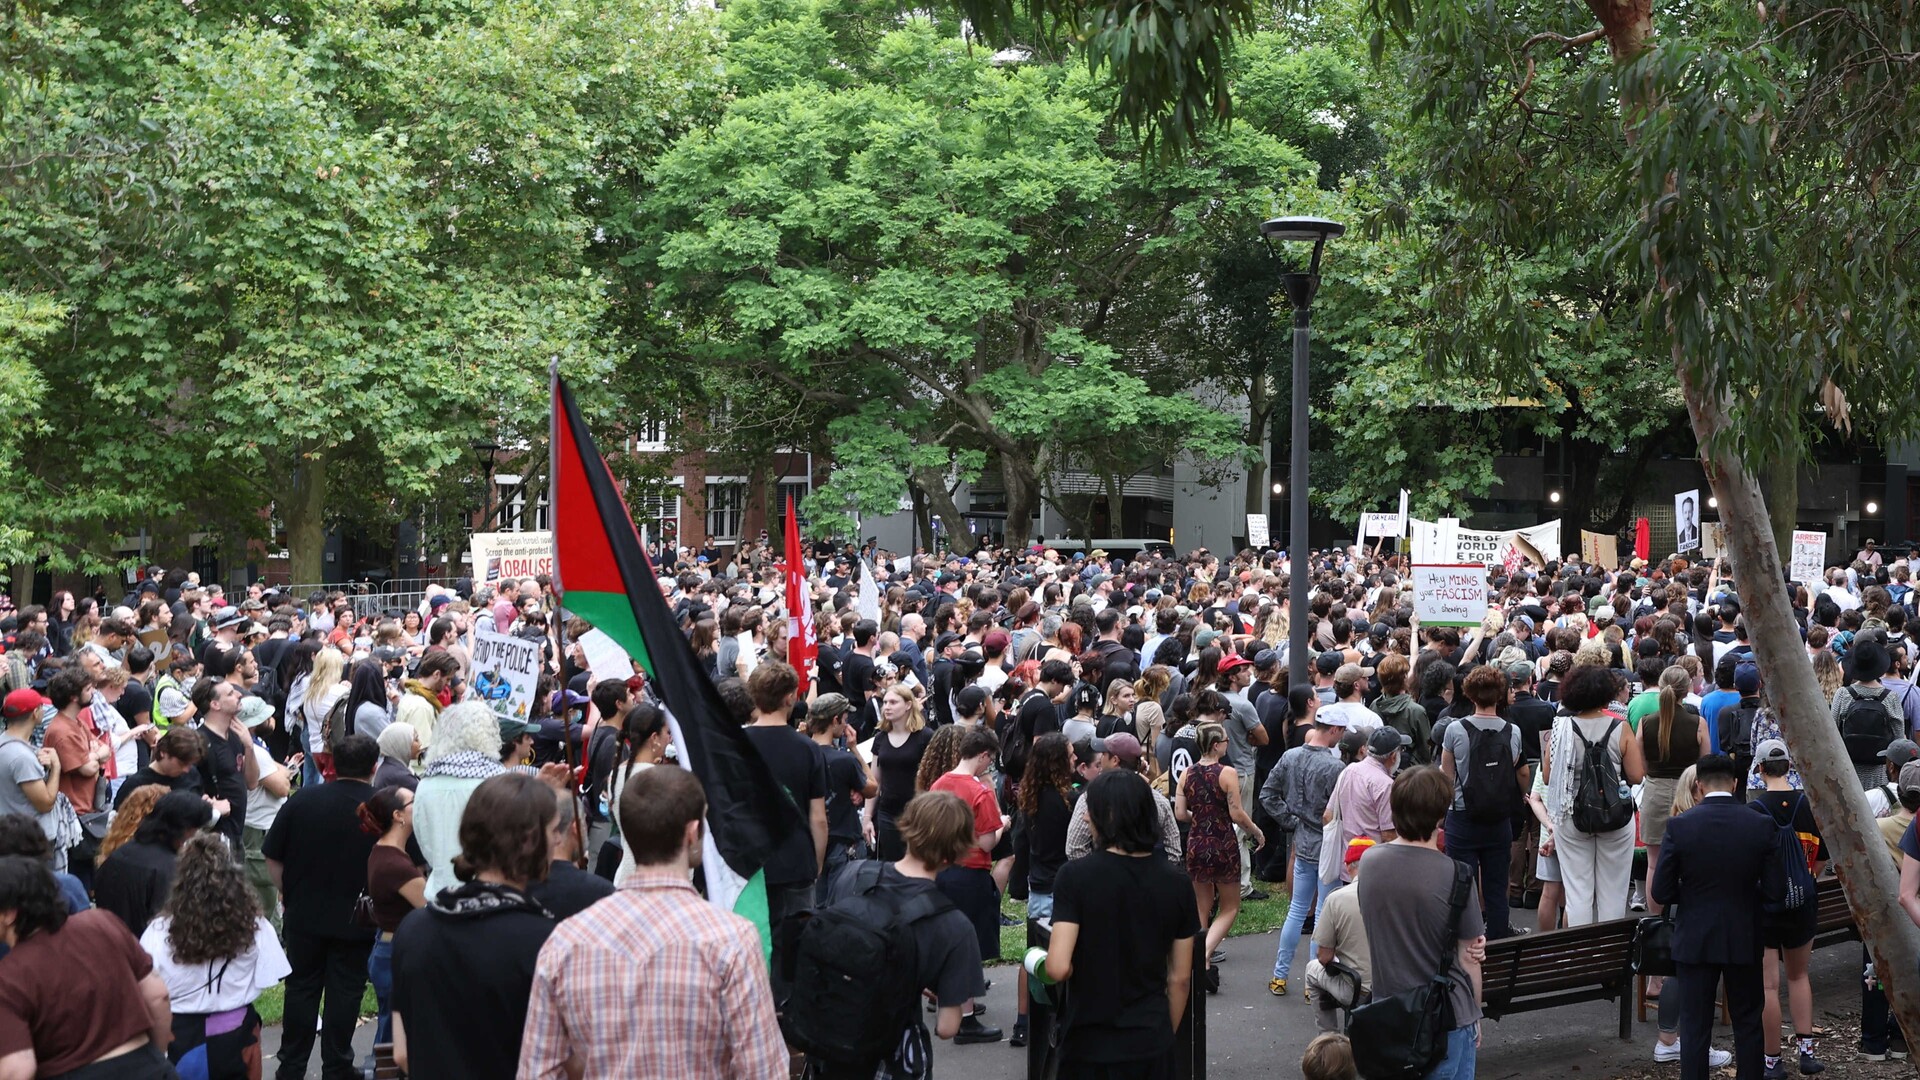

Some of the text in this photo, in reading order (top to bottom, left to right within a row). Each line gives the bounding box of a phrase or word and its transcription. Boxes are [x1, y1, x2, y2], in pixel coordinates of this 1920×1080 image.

[496, 537, 522, 546] Sanction
[522, 536, 538, 544] Israel
[1680, 540, 1698, 551] FASCIST
[485, 548, 502, 557] Scrap
[504, 548, 513, 556] the
[514, 546, 548, 556] anti-protest
[1469, 553, 1494, 561] FOR
[500, 558, 552, 578] LOBALISE
[1428, 573, 1446, 588] Hey
[1420, 588, 1482, 601] your FASCISM
[1428, 604, 1468, 618] is showing
[492, 641, 506, 658] THE
[504, 644, 533, 675] POLICE
